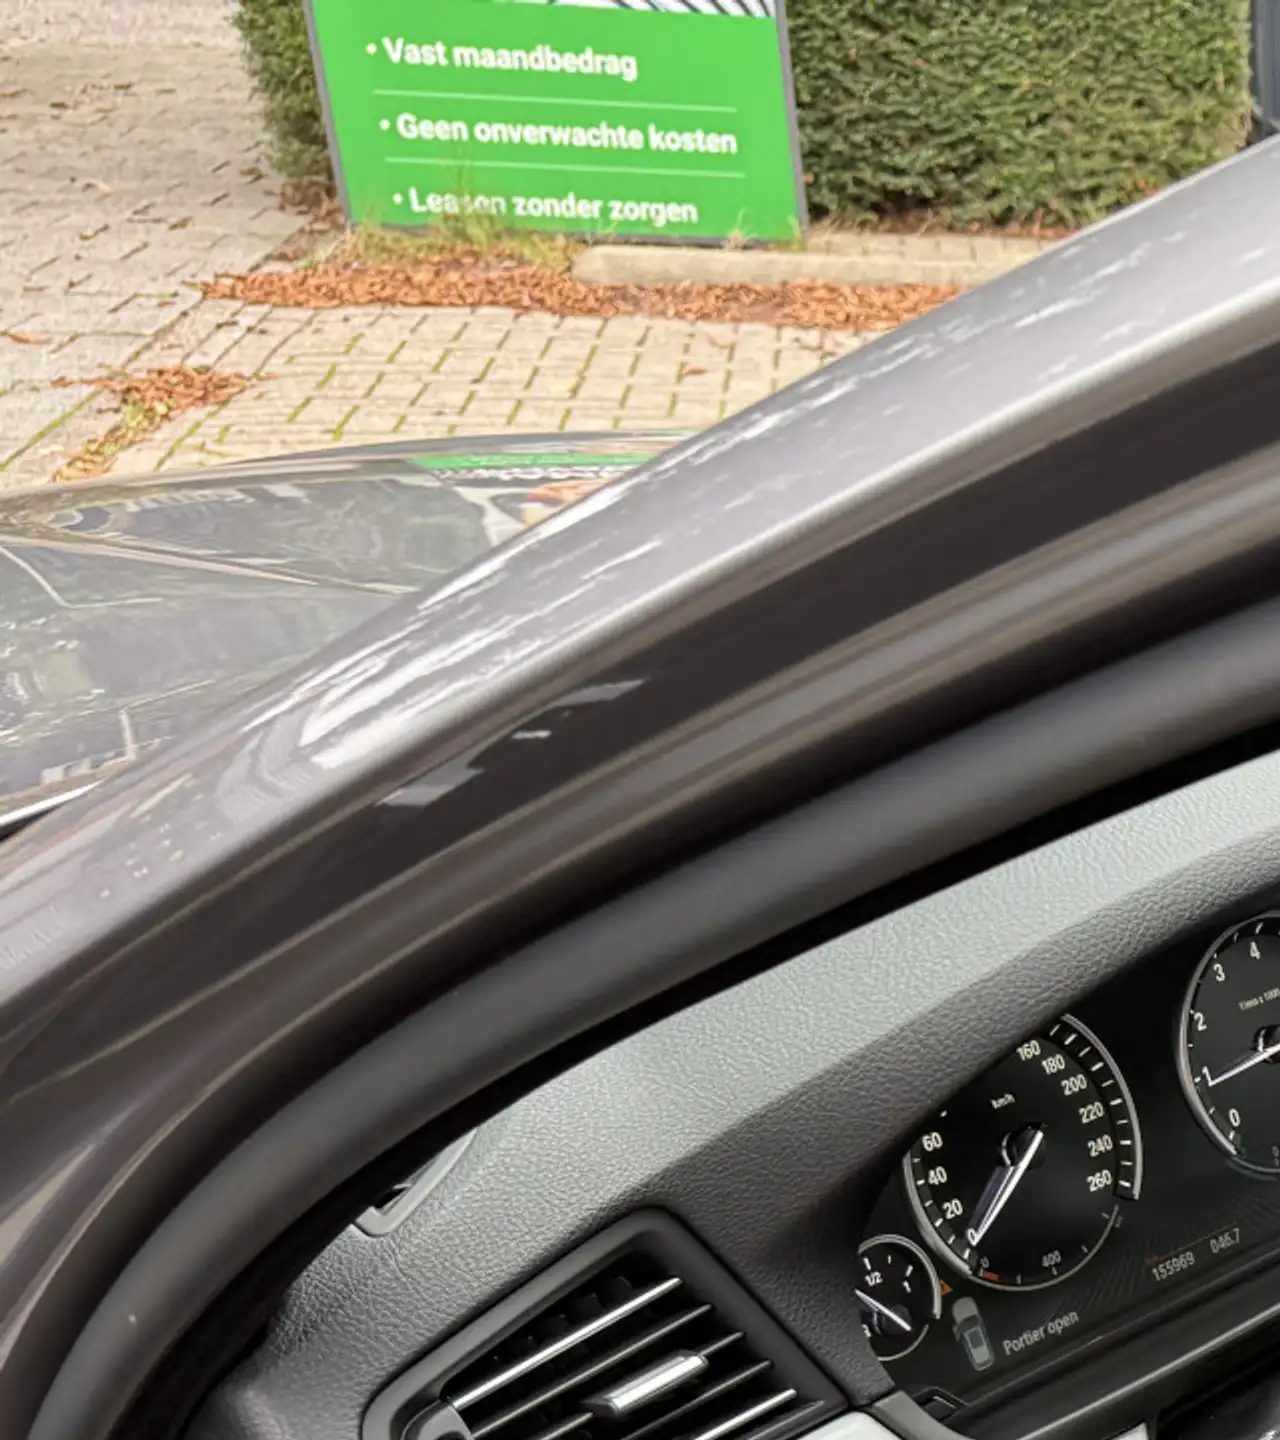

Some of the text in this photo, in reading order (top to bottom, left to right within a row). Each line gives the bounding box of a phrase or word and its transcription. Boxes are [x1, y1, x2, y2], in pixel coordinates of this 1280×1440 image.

[381, 36, 638, 82] Vast maandbedrag
[396, 112, 738, 155] Geen onverwachte kosten
[512, 191, 603, 219] zonder
[608, 200, 698, 228] zorgen
[1249, 941, 1261, 960] 4
[1213, 963, 1226, 982] 3
[1194, 1012, 1208, 1031] 2
[1016, 1040, 1041, 1062] 160
[1041, 1054, 1066, 1075] 180
[1061, 1073, 1088, 1096] 200
[1078, 1102, 1105, 1124] 220
[1228, 1108, 1241, 1127] 0
[922, 1132, 944, 1152] 60
[1088, 1134, 1113, 1157] 240
[927, 1166, 948, 1186] 40
[1086, 1169, 1112, 1193] 260
[943, 1198, 964, 1220] 20
[1002, 1311, 1080, 1356] Portier open
